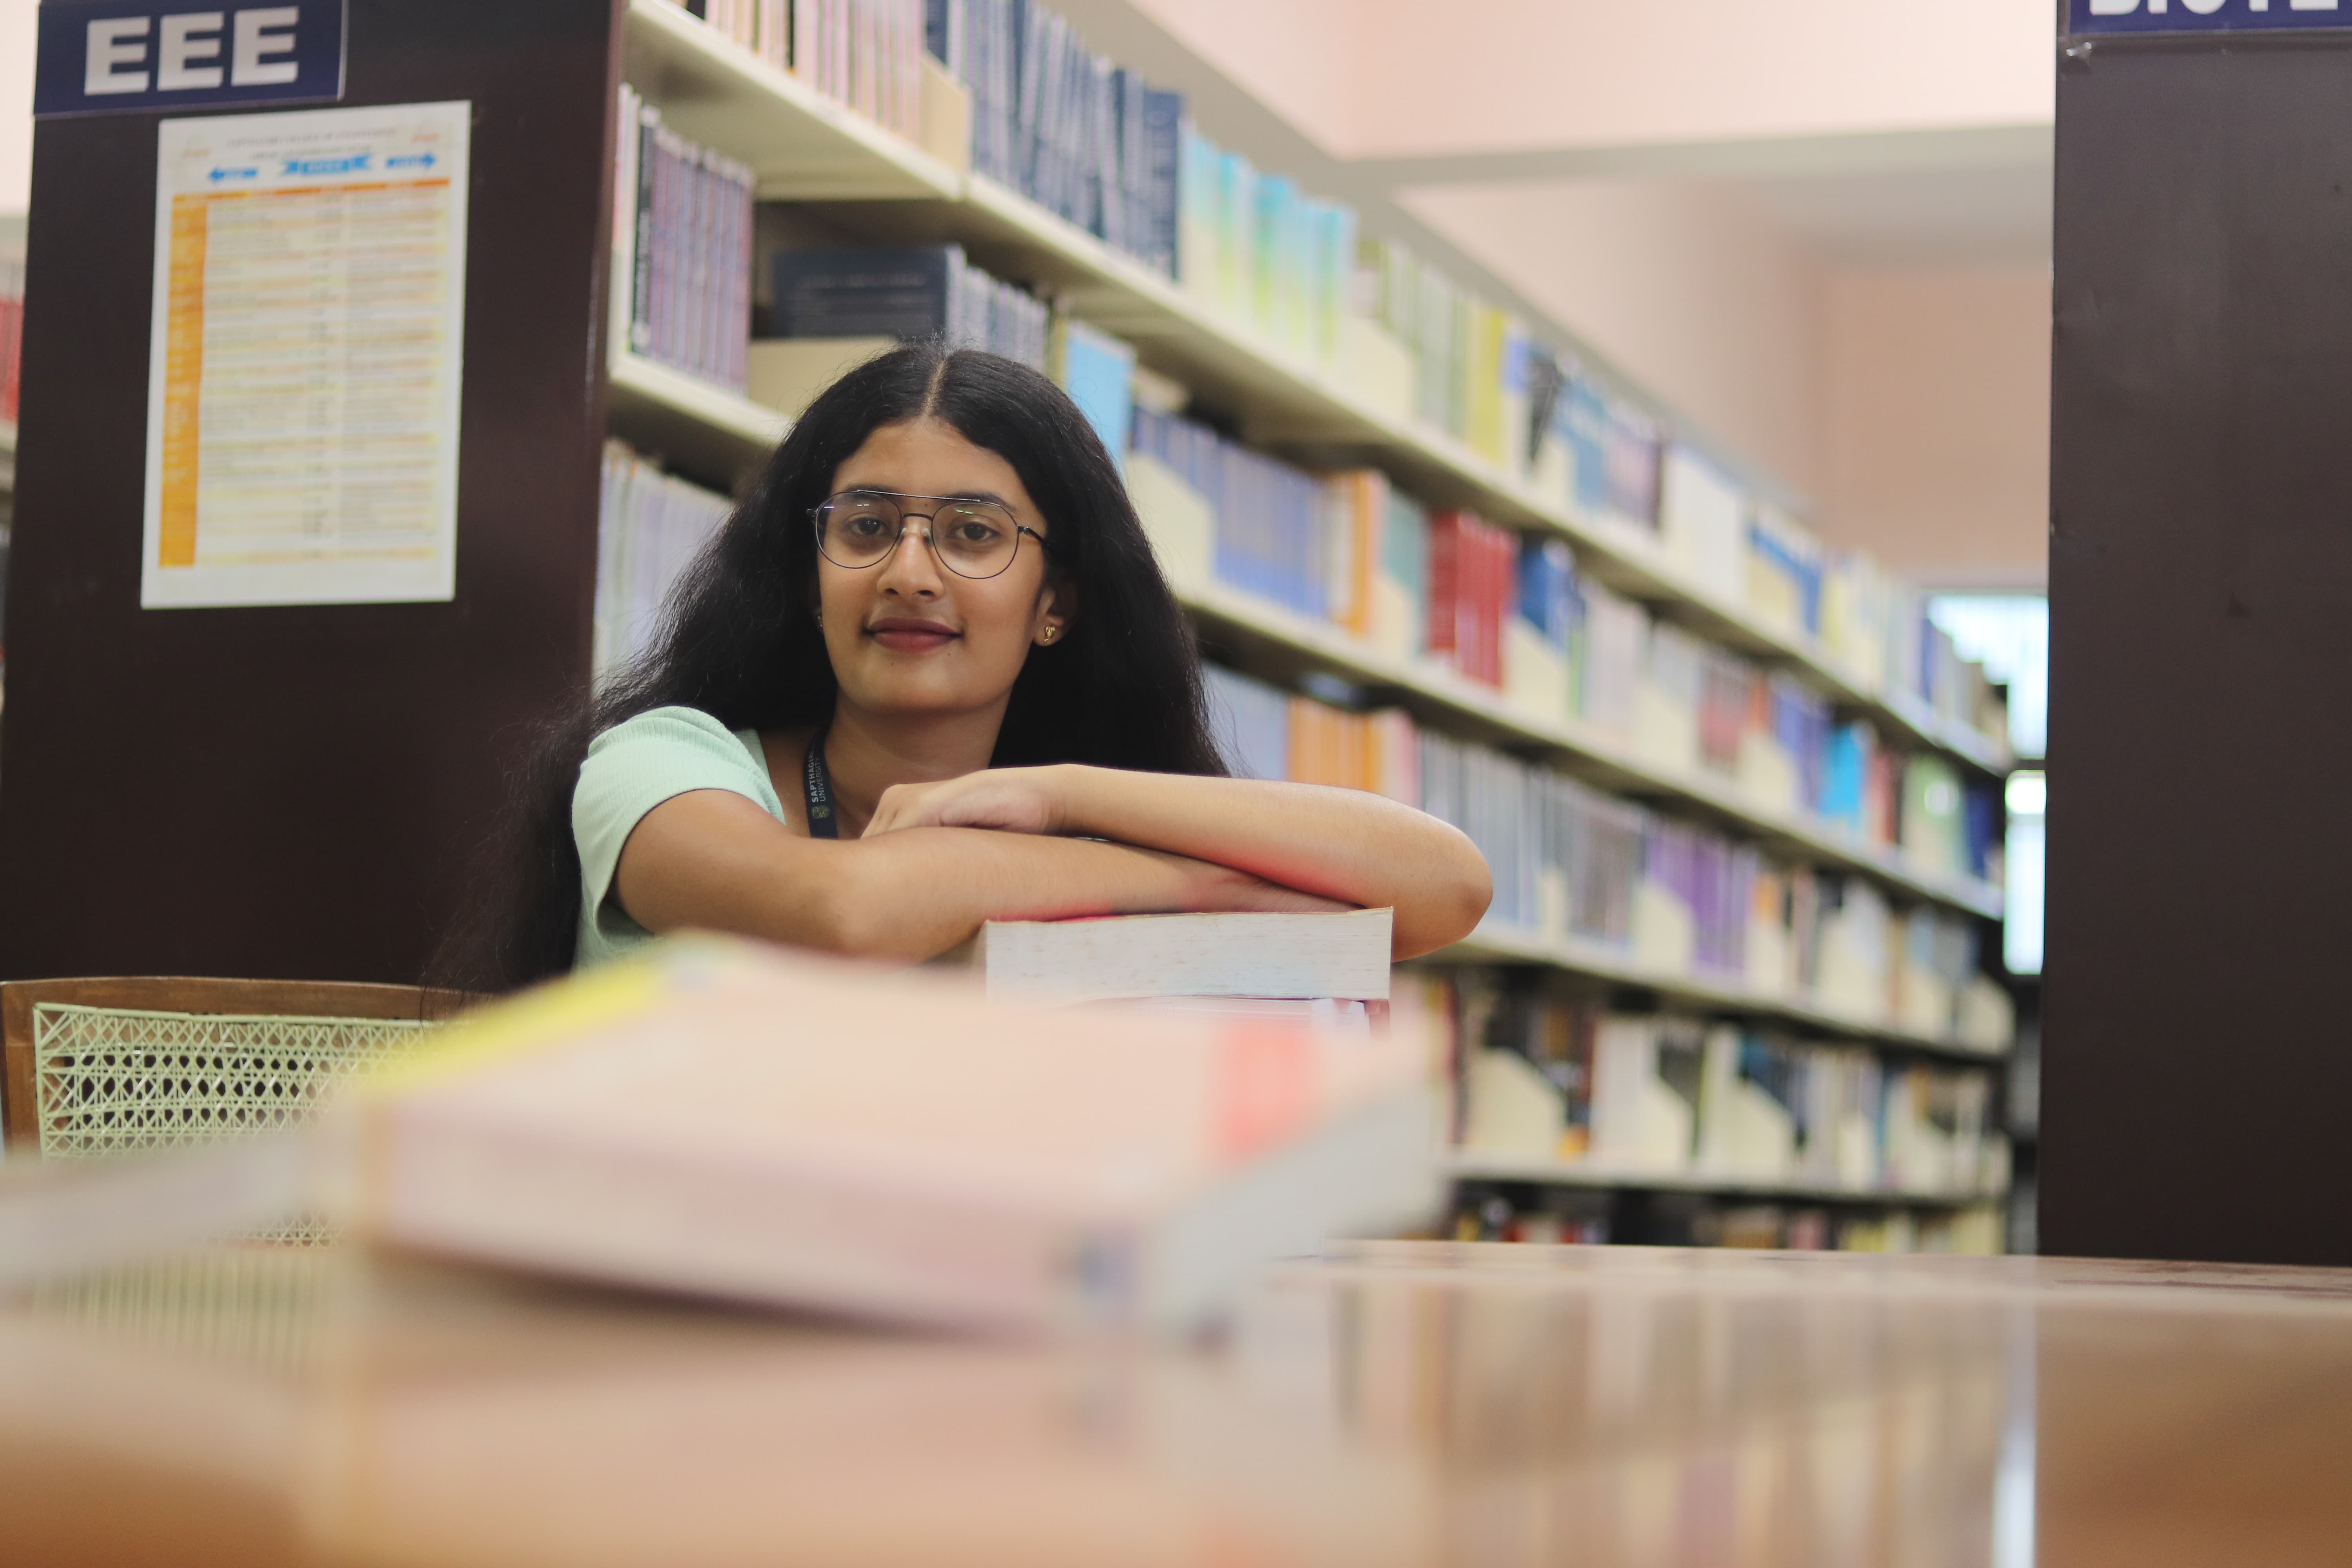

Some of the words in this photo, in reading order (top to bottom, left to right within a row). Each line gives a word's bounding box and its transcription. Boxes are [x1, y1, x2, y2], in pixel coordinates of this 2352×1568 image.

[84, 5, 299, 96] EEE
[808, 750, 818, 803] SAPTHAGIRI
[815, 757, 826, 802] UNIVERSITY
